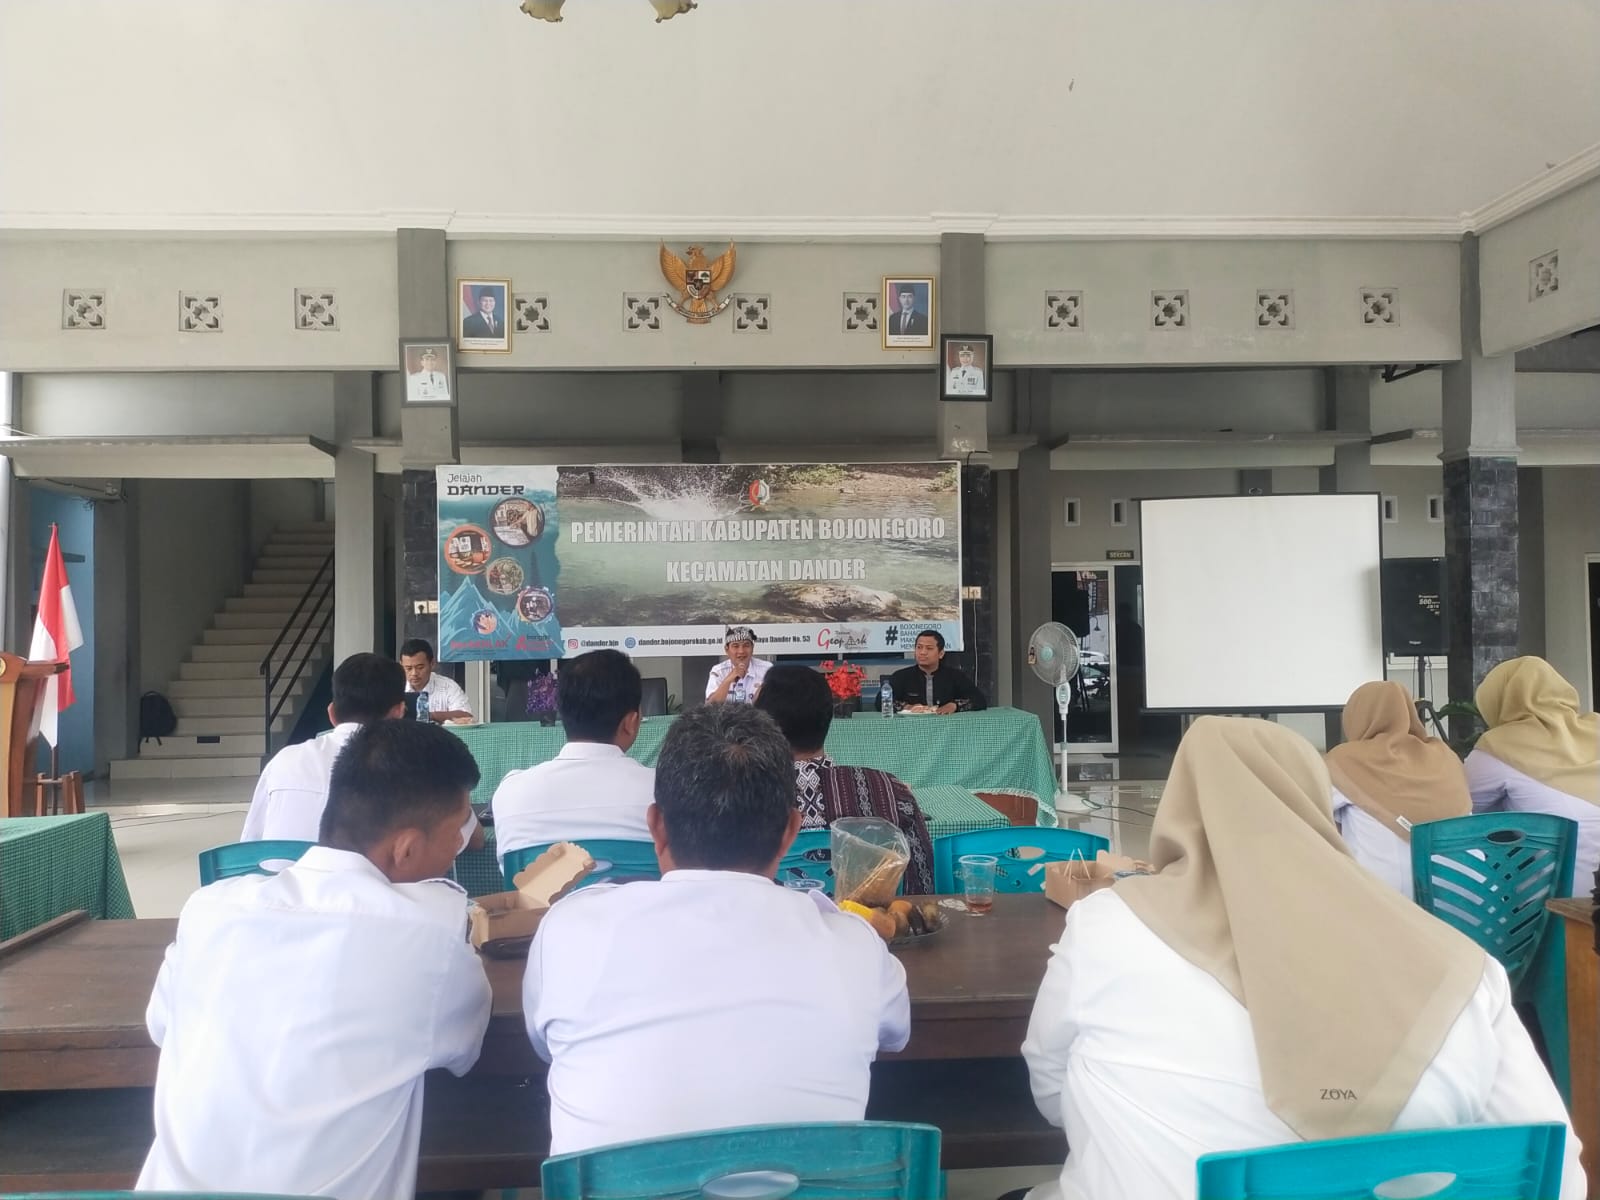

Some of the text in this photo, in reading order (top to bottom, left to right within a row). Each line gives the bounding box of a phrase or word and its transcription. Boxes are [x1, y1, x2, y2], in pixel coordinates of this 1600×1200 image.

[447, 473, 482, 483] Jelajah
[447, 484, 525, 496] DANDER
[570, 517, 945, 543] PEMERINTAH KABUPATEN BOJONEGORO
[666, 558, 866, 583] KECAMATAN DANDER
[1319, 1088, 1358, 1101] ZOYA
